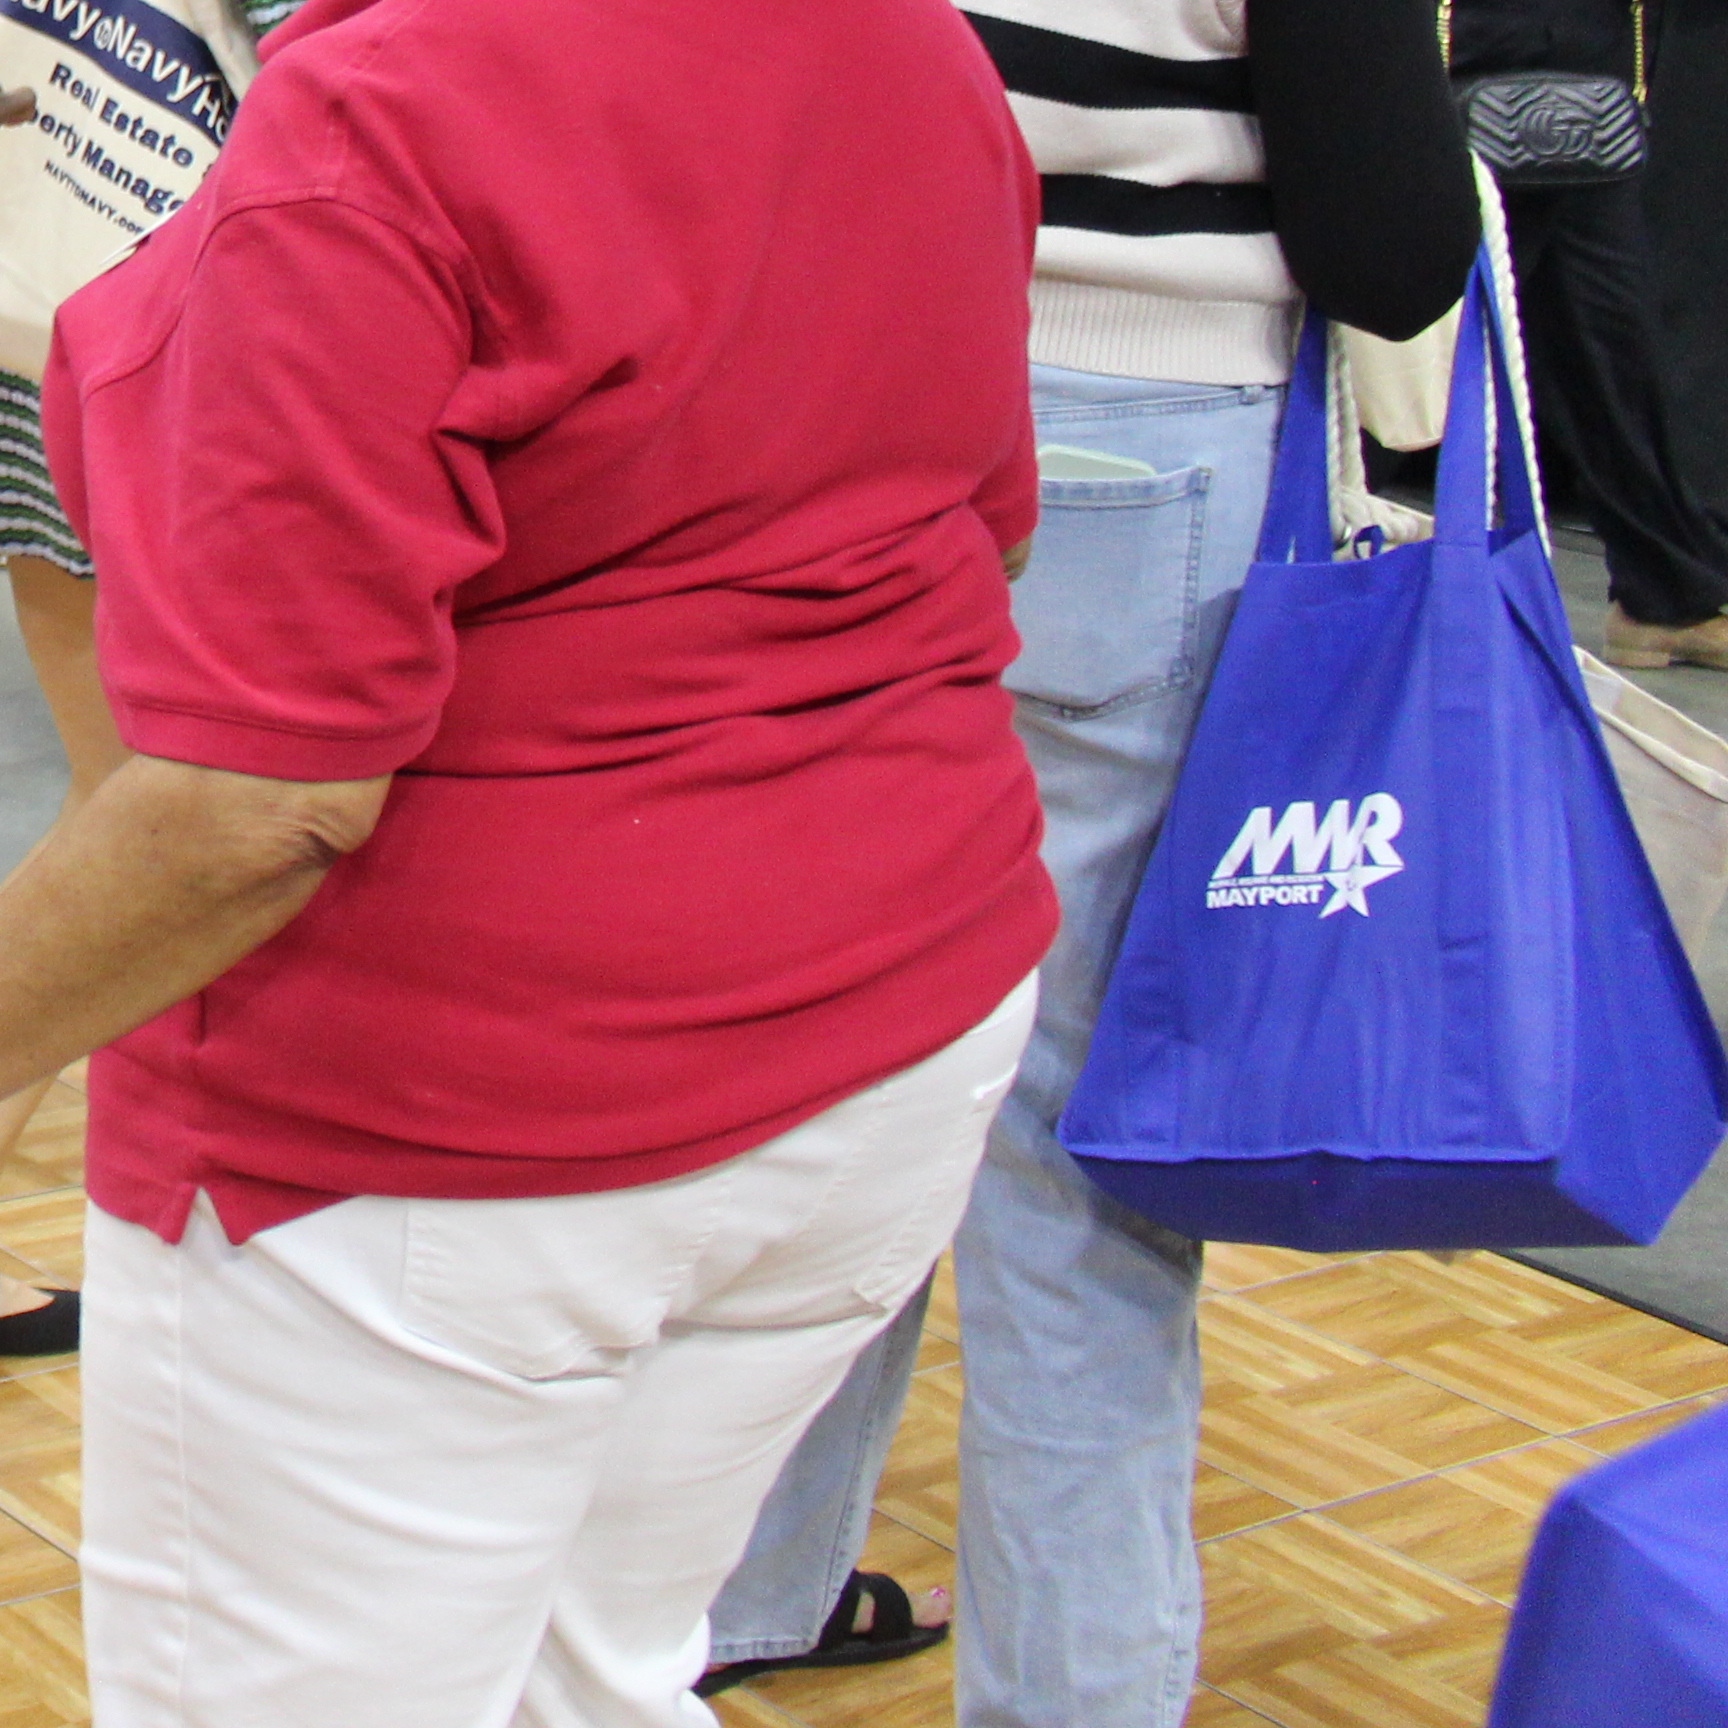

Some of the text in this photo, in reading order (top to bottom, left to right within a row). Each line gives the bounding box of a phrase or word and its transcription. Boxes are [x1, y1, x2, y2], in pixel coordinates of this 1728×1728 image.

[49, 61, 195, 169] Real Estate
[1205, 883, 1325, 910] MAYPORT
